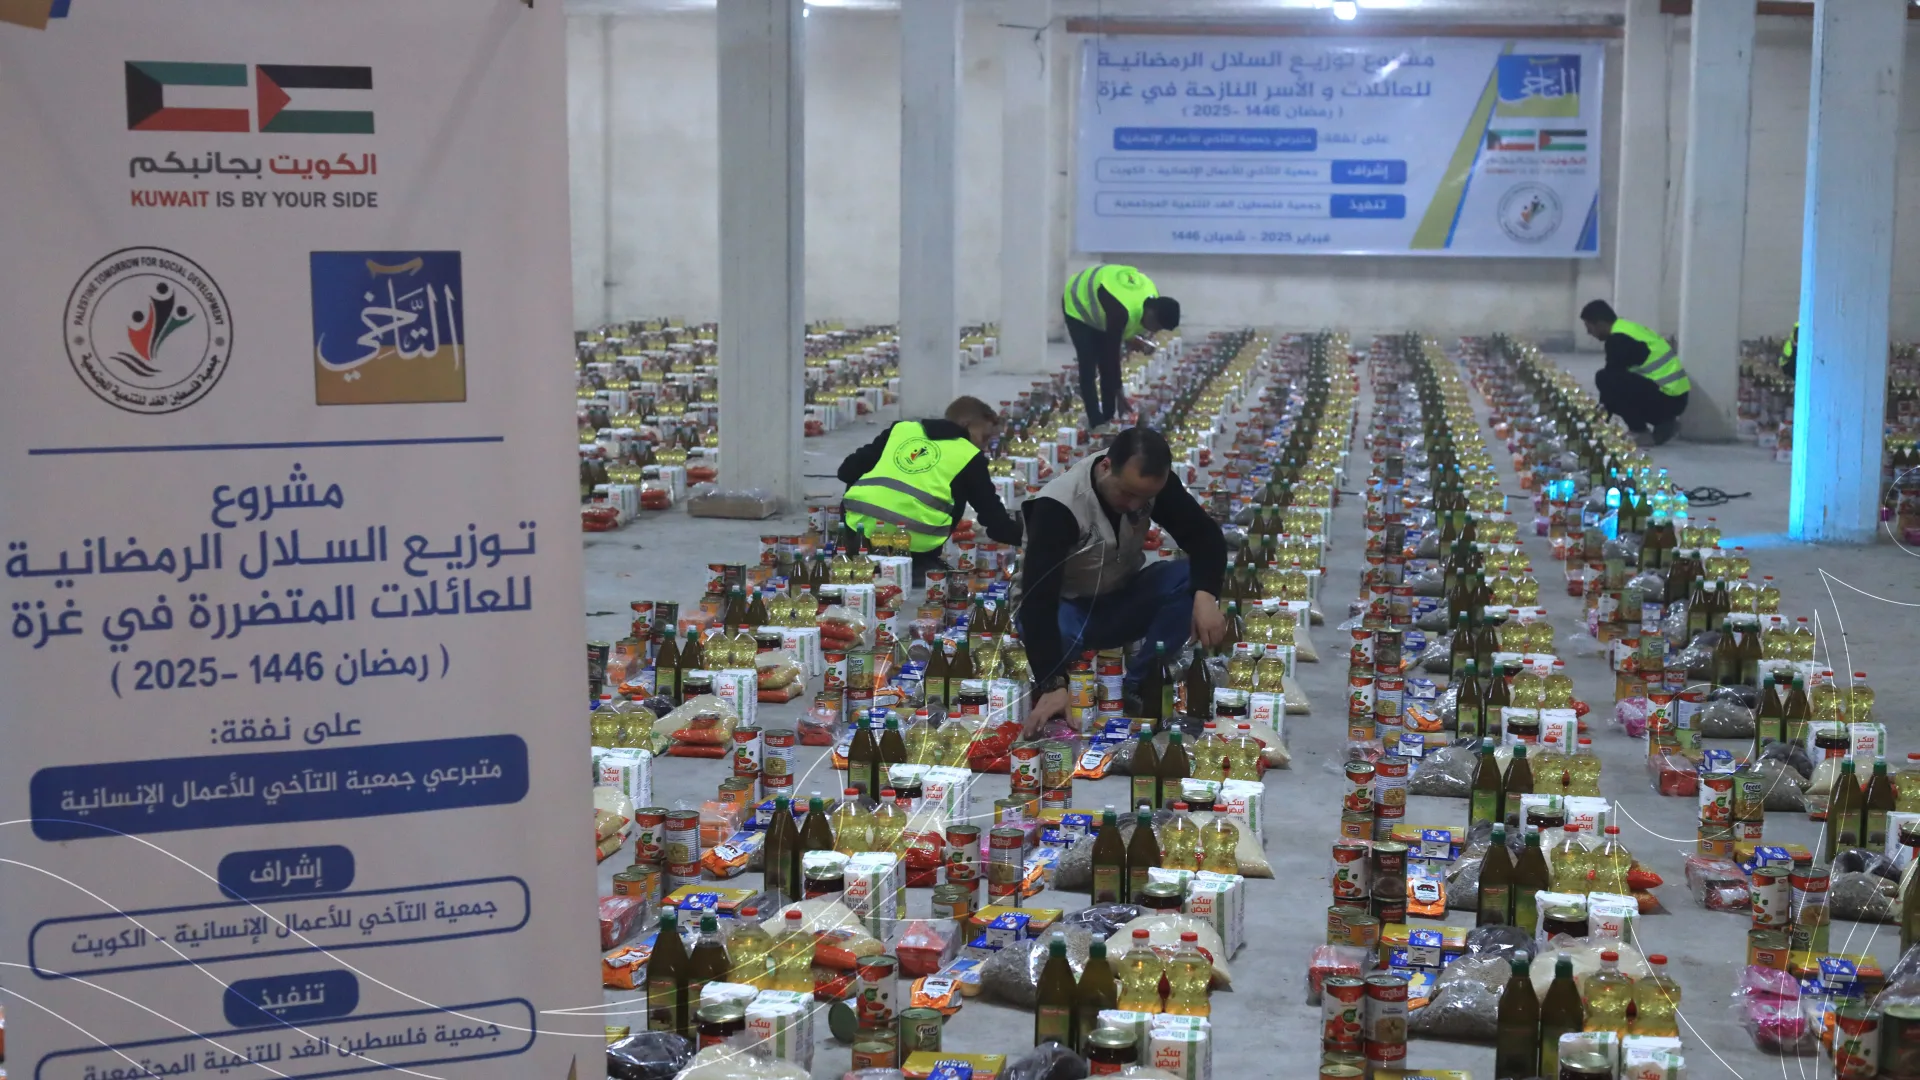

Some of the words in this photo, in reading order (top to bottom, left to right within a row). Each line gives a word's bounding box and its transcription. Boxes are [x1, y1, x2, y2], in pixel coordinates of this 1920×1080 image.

[1142, 81, 1177, 104] في
[129, 150, 263, 179] بجانبكم
[269, 153, 377, 180] الكويت
[131, 189, 209, 208] KUWAIT
[216, 190, 235, 208] IS
[241, 190, 267, 208] BY
[272, 190, 327, 208] YOUR
[331, 190, 379, 208] SIDE
[74, 282, 98, 327] PALESTINE
[94, 257, 140, 285] TOMORROW
[140, 256, 157, 267] FOR
[159, 258, 186, 279] SOCIAL
[186, 272, 224, 326] DEVELOPMENT
[210, 462, 344, 530] مشروع
[5, 532, 224, 589] الرمضانية
[239, 525, 388, 580] السلال
[188, 584, 356, 640] المتضررة
[370, 575, 532, 620] للعائلات
[12, 598, 84, 650] غزة
[101, 594, 174, 653] في
[248, 651, 324, 685] 1446
[334, 647, 429, 686] رمضان
[210, 716, 291, 746] نفقة:
[303, 712, 362, 745] على
[171, 772, 255, 810] للأعمال
[261, 768, 338, 805] التآخي
[345, 766, 417, 796] جمعية
[422, 759, 503, 792] متبرعي
[59, 784, 165, 815] الإنسانية
[248, 856, 324, 890] إشراف
[433, 897, 499, 924] جمعية
[1191, 896, 1212, 905] سكر
[173, 913, 268, 945] الإنسانية
[274, 904, 352, 940] للأعمال
[358, 900, 427, 937] التآخي
[71, 926, 147, 959] الكويت
[258, 982, 326, 1015] تنفيذ
[433, 1022, 501, 1049] جمعية
[749, 1019, 771, 1029] سكر
[203, 1042, 282, 1075] للتنمية
[288, 1036, 331, 1063] الغد
[336, 1027, 428, 1058] فلسطين
[1156, 1047, 1181, 1058] سكر
